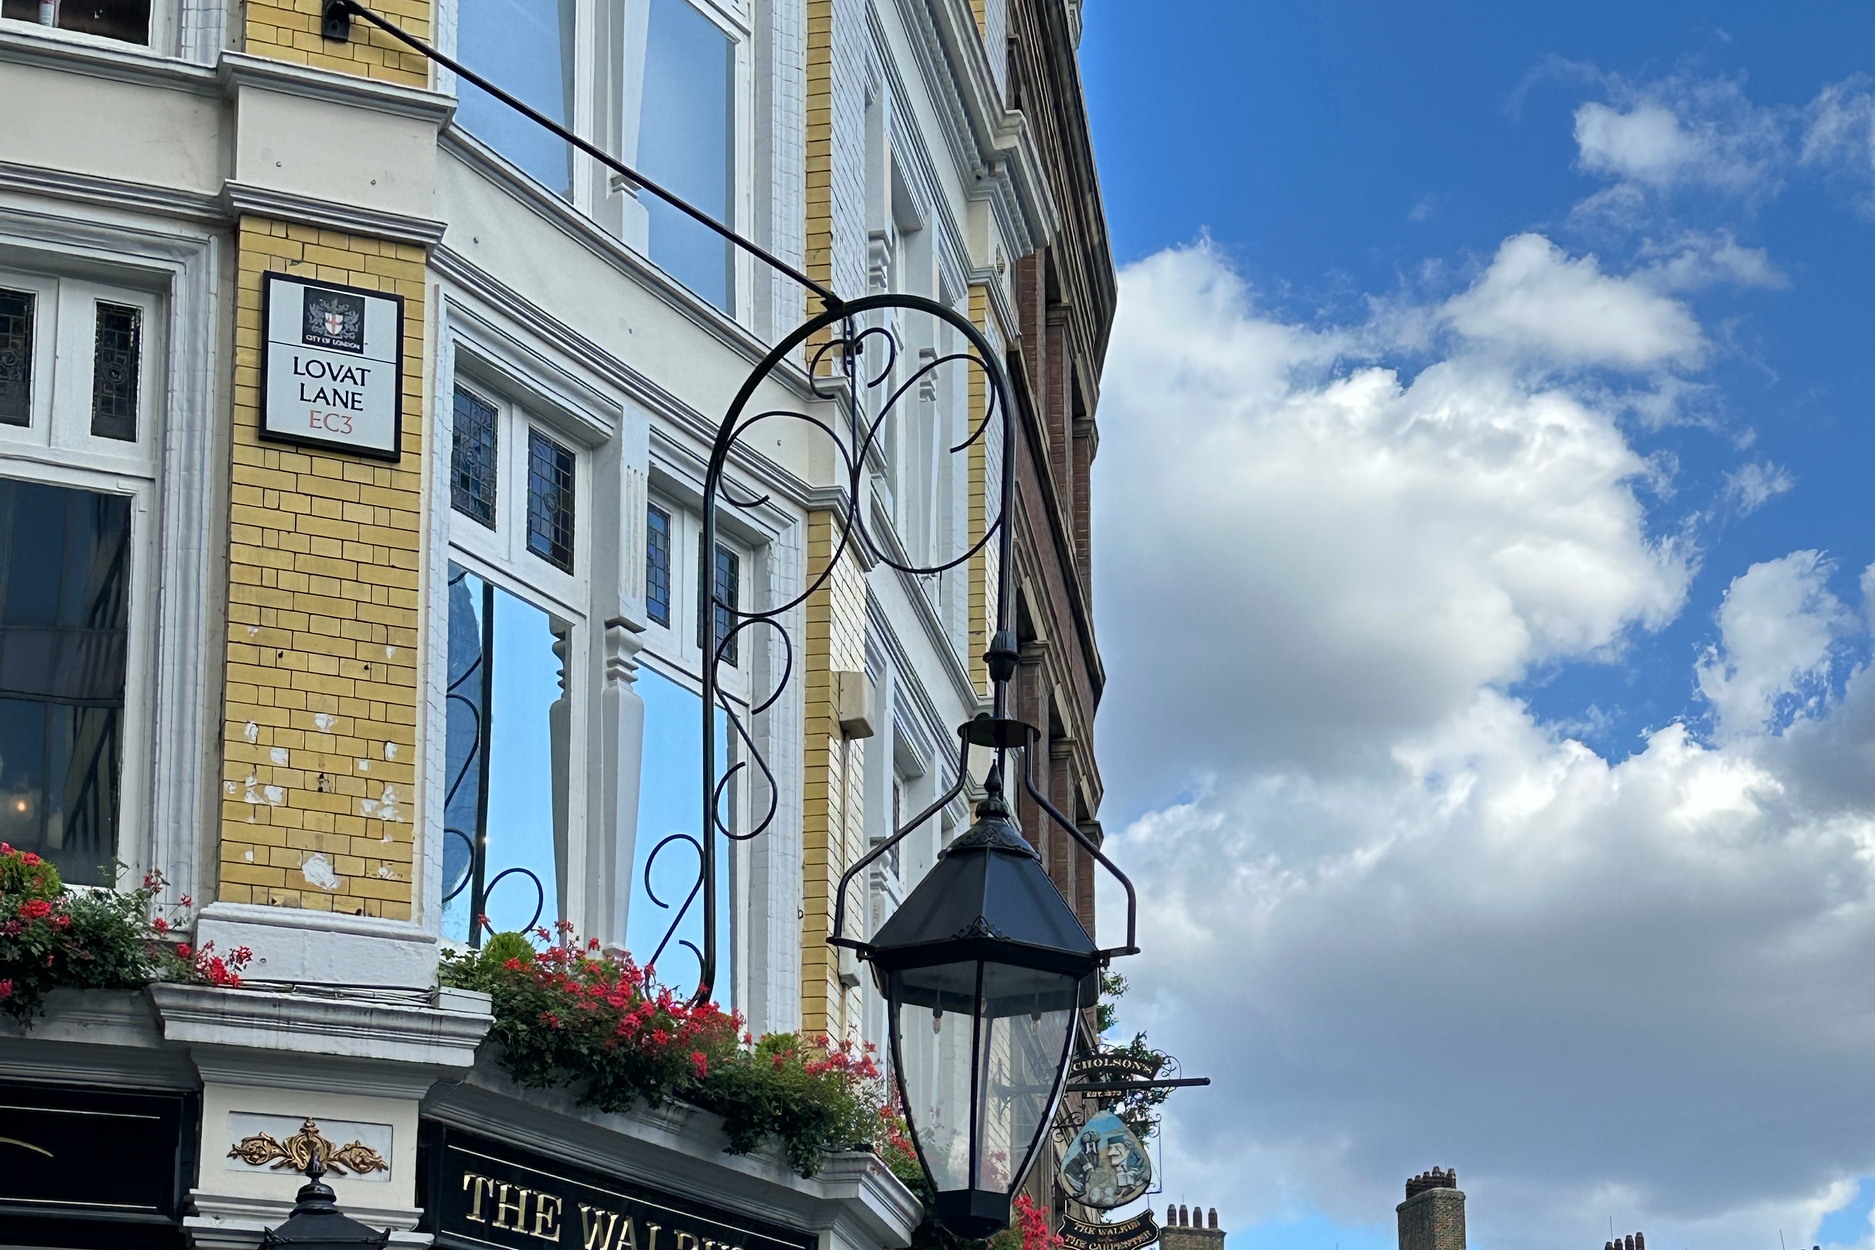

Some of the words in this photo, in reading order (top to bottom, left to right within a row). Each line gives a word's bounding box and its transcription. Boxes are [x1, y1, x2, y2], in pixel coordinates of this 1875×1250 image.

[305, 334, 320, 343] CITY
[332, 339, 360, 349] LONDON
[293, 356, 371, 386] LOVAT
[300, 382, 364, 411] LANE
[309, 409, 353, 435] EC3
[1072, 1058, 1153, 1074] CHOLSON'S
[462, 1170, 563, 1243] THE
[1074, 1222, 1095, 1235] THE
[1098, 1220, 1140, 1236] WALRUS
[1065, 1233, 1088, 1249] THE
